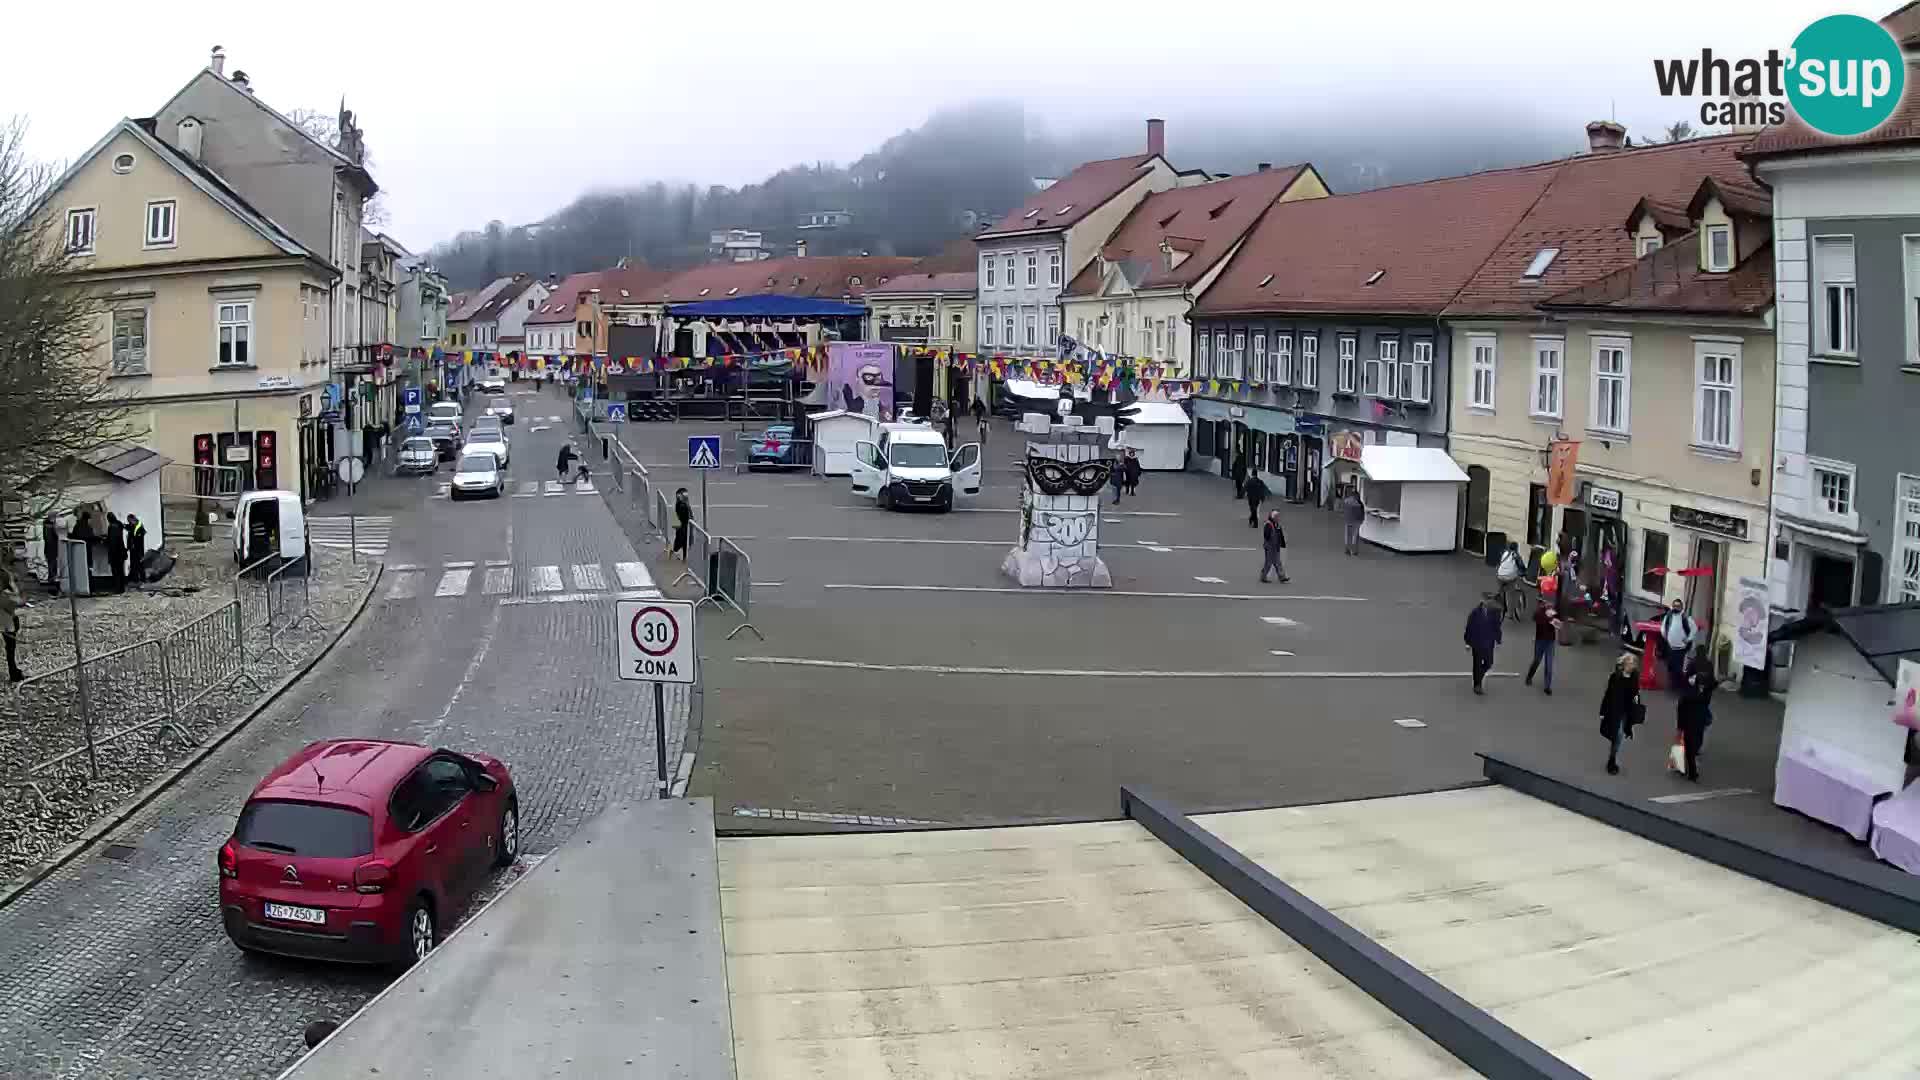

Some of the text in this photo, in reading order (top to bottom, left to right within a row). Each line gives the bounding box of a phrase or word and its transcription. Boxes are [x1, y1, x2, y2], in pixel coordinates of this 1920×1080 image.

[408, 392, 416, 402] P
[1047, 516, 1087, 546] 200
[643, 622, 668, 643] 30
[634, 659, 678, 676] ZONA
